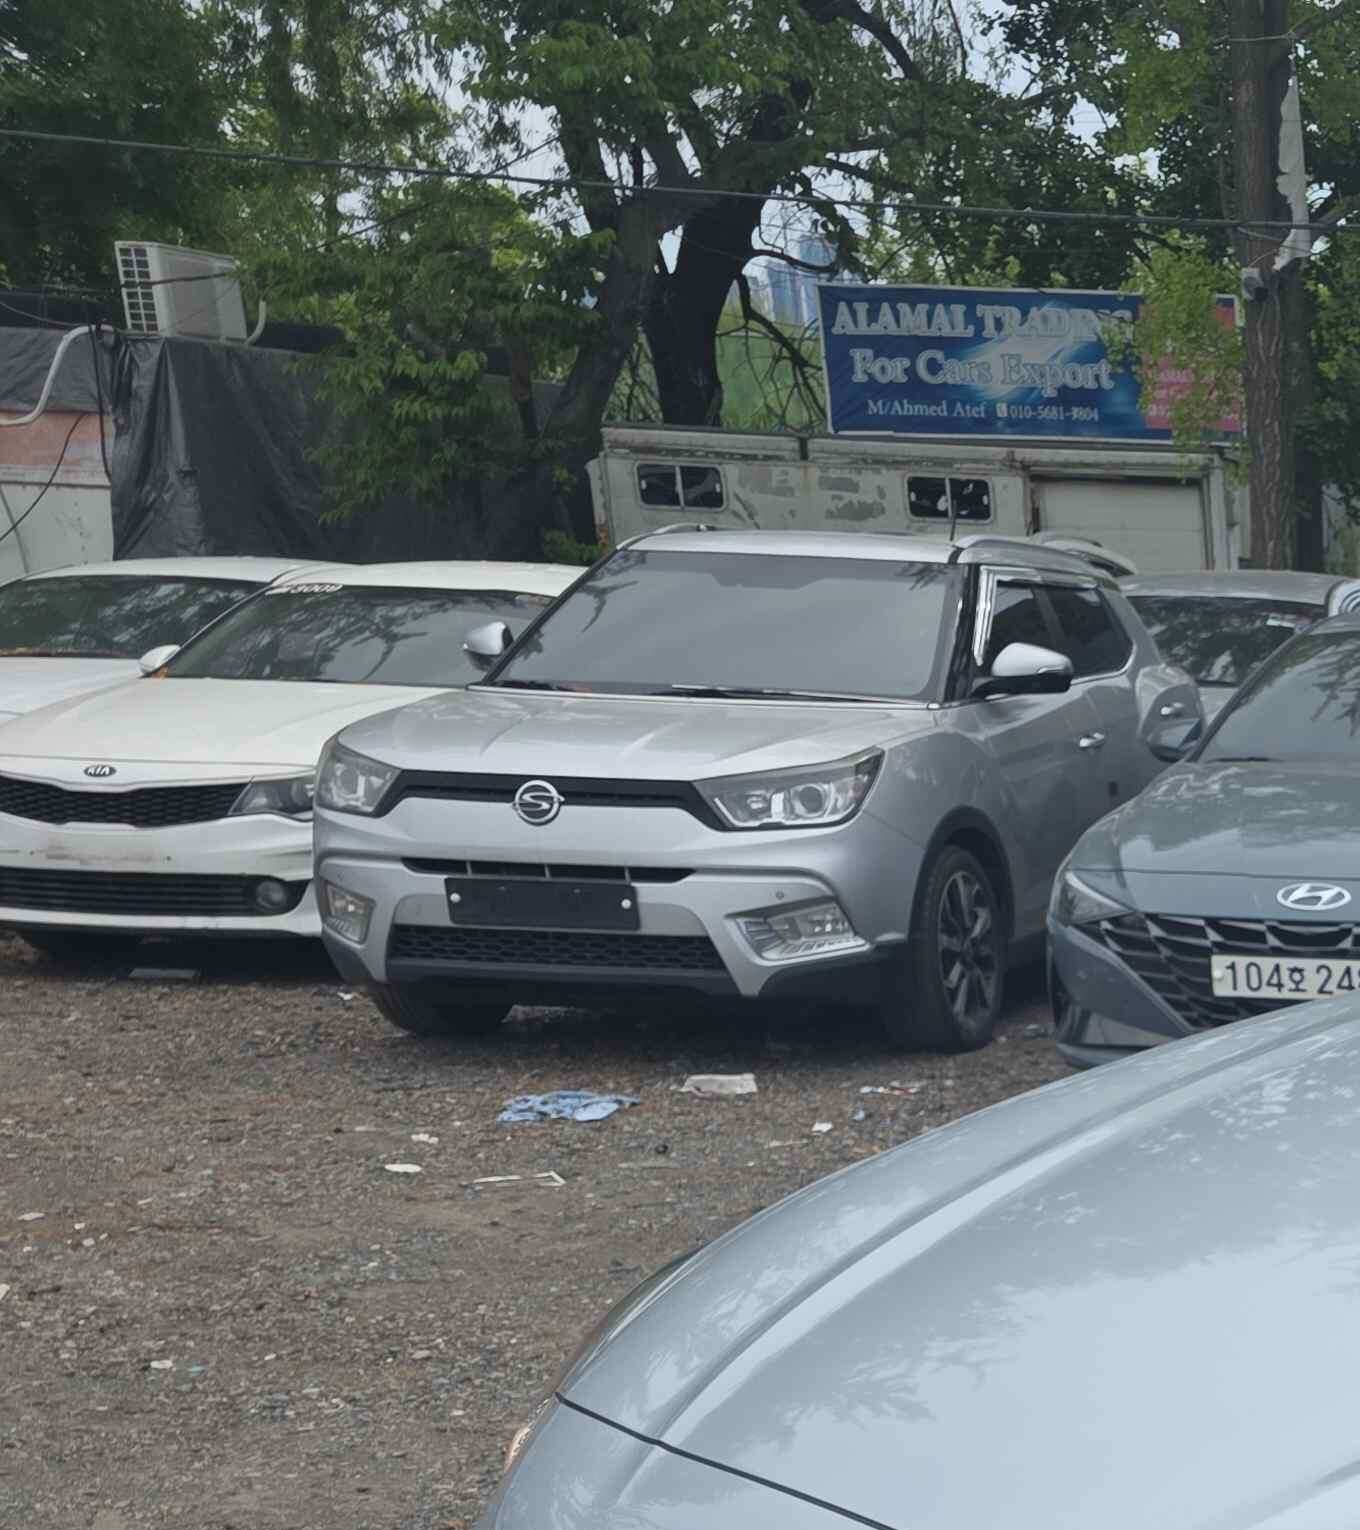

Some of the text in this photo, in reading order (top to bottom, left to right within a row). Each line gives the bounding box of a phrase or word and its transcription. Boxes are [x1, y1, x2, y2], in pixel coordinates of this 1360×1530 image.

[831, 301, 975, 338] ALAMAL
[849, 348, 912, 384] For
[915, 349, 994, 386] Cars
[1000, 352, 1116, 399] Export
[867, 398, 948, 418] M/Ahmed
[86, 765, 112, 777] KIA
[1225, 961, 1308, 994] 104호
